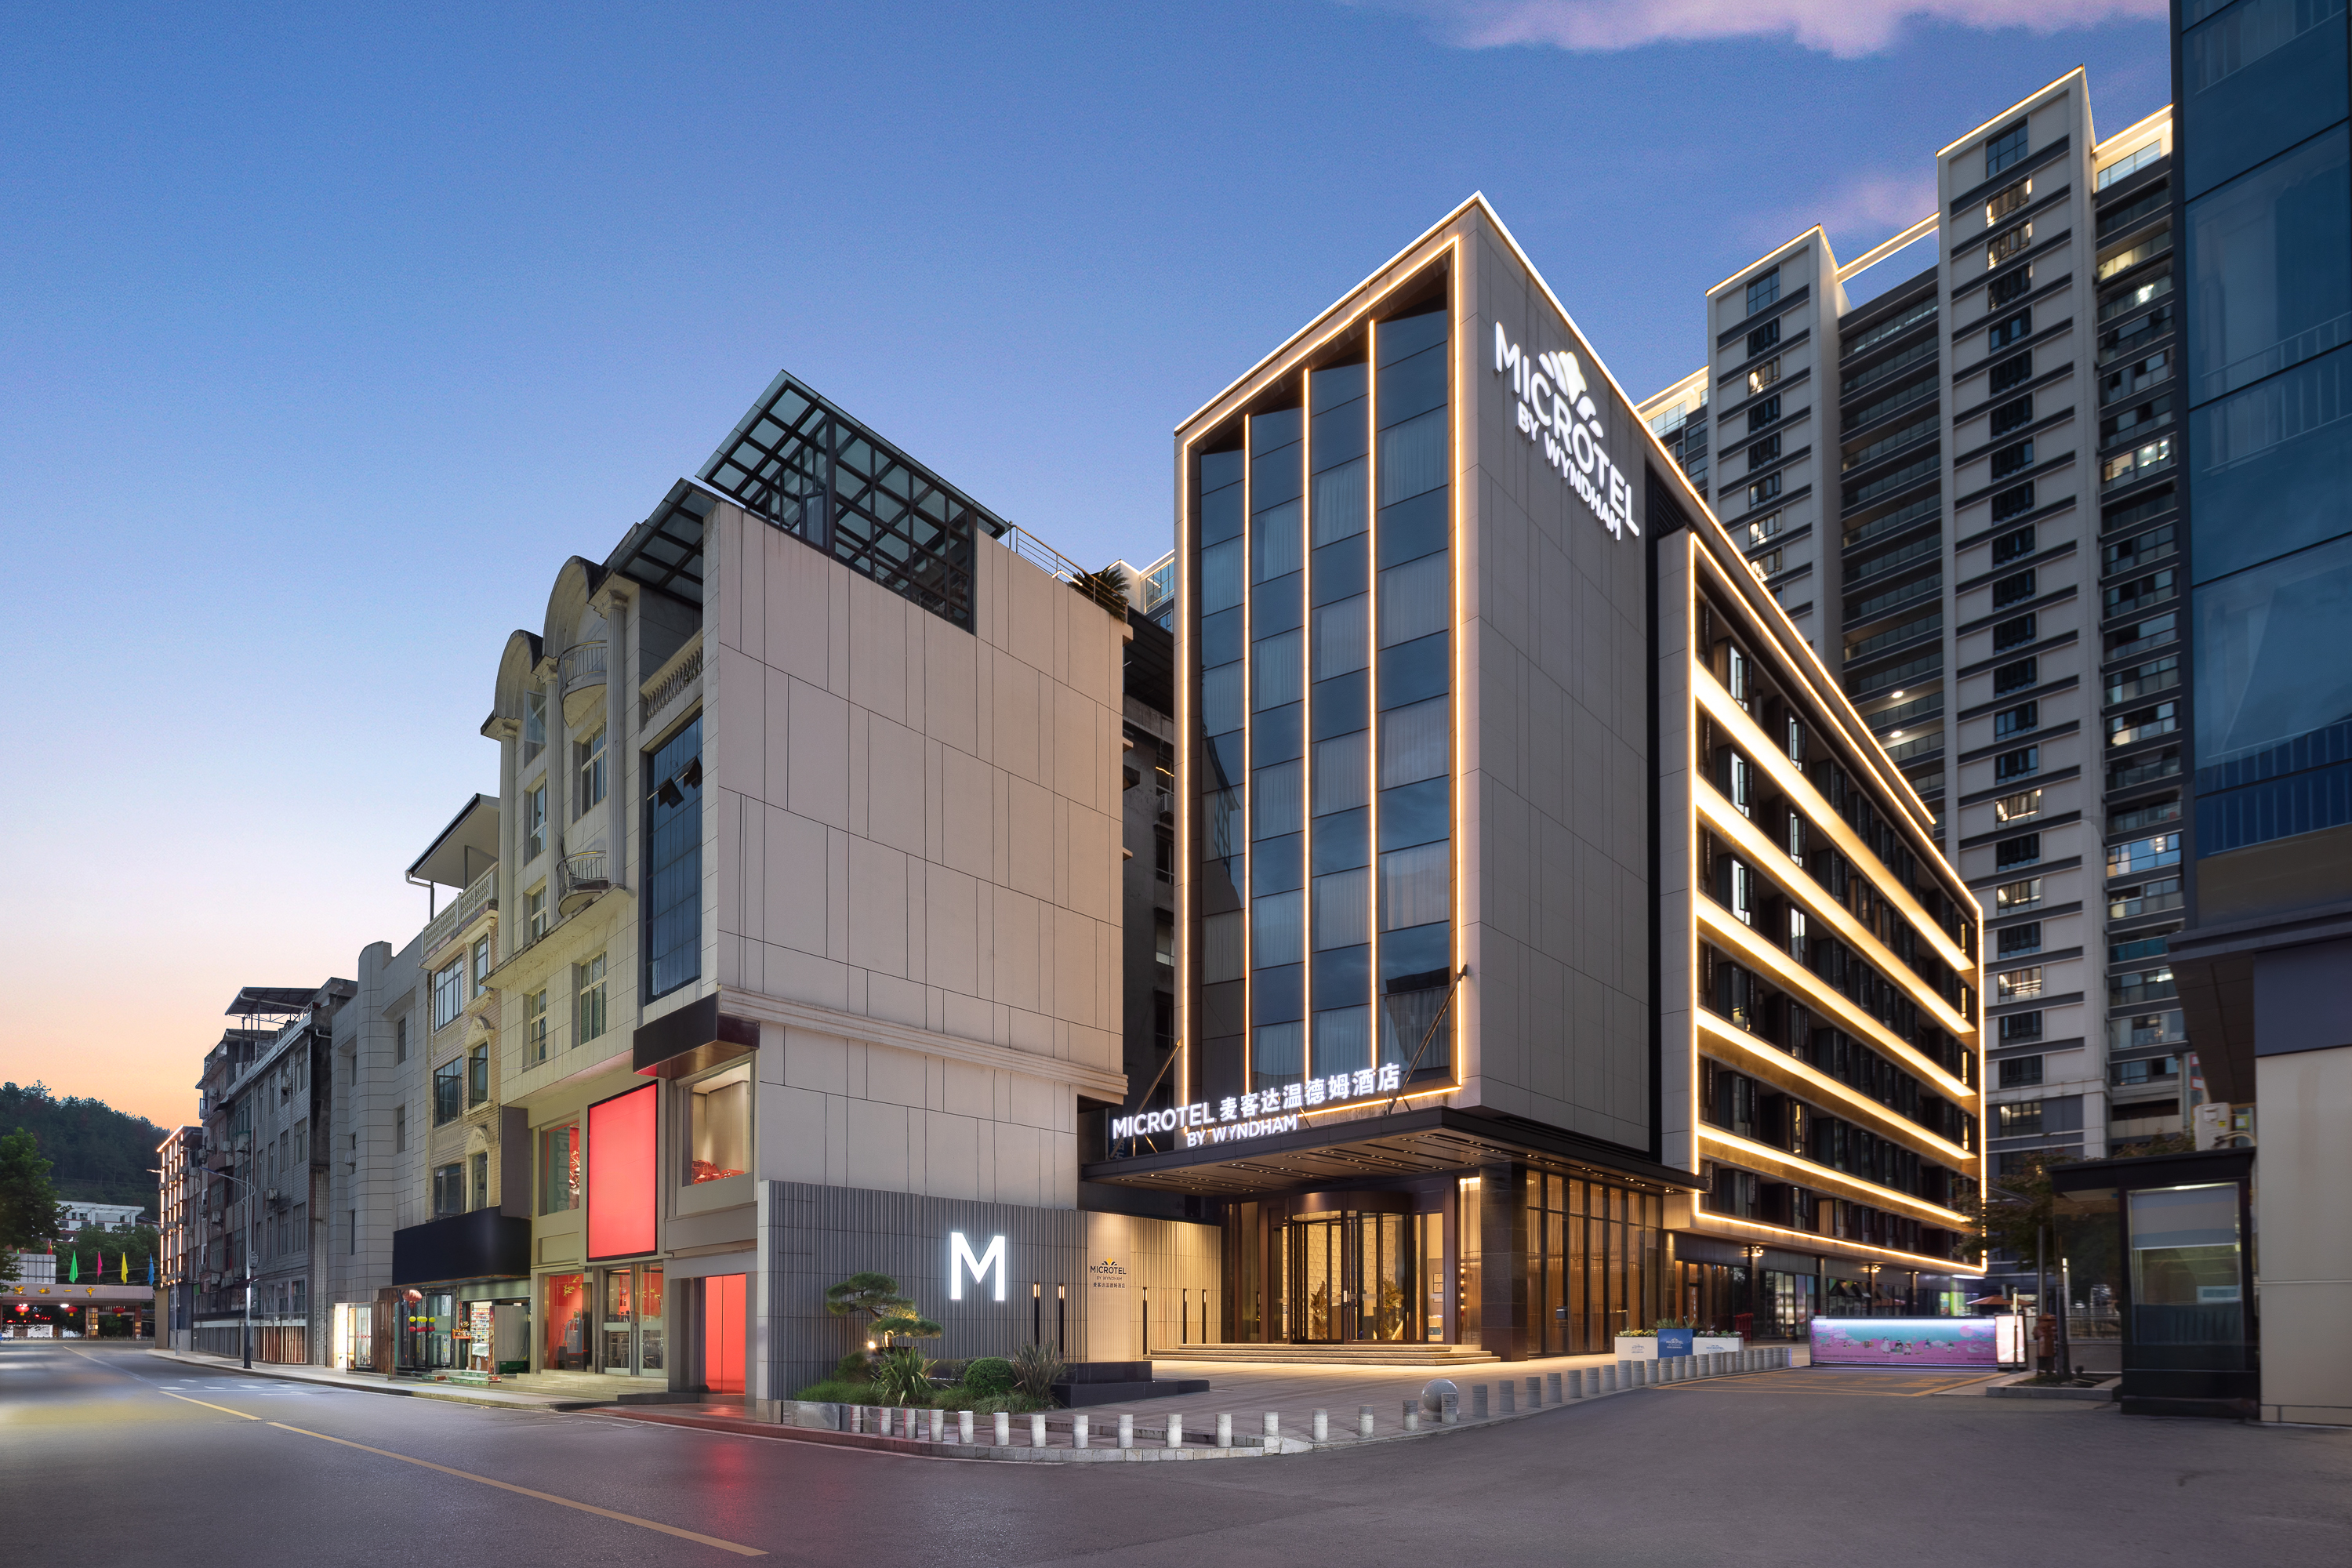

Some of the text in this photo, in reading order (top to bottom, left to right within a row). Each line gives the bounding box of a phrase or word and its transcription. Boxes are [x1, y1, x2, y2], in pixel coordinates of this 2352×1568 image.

[1495, 321, 1639, 536] MICROTEL
[1518, 401, 1621, 540] BY WYNDHAM
[1112, 1062, 1401, 1139] MICROTEL 麦客达温德姆酒店
[1187, 1113, 1298, 1148] BY WYNDHAM
[951, 1232, 1005, 1301] M
[1090, 1265, 1127, 1275] MICROTEL
